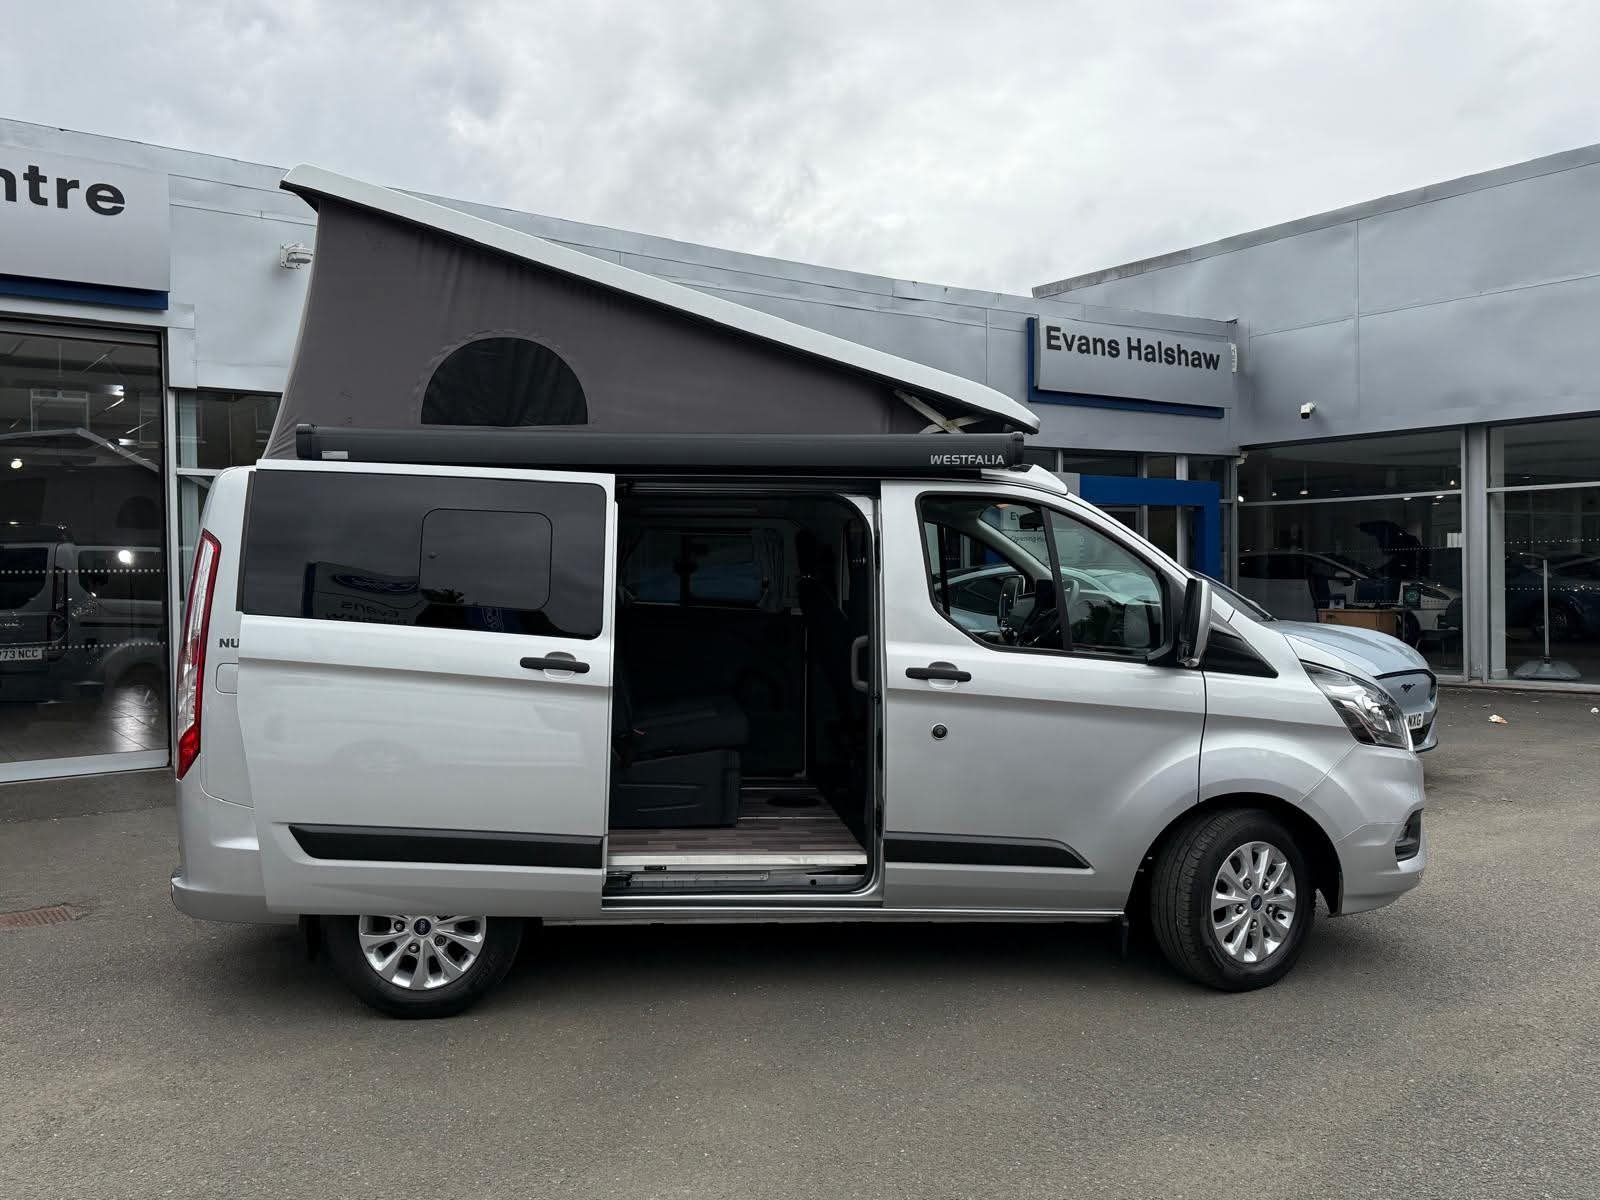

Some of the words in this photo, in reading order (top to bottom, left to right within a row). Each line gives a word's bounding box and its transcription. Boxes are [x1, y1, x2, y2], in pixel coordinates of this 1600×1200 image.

[1045, 325, 1120, 359] Evans
[1126, 336, 1220, 371] Halshaw
[930, 454, 1005, 465] WESTFALIA
[0, 650, 16, 659] 73
[18, 649, 38, 659] NCC
